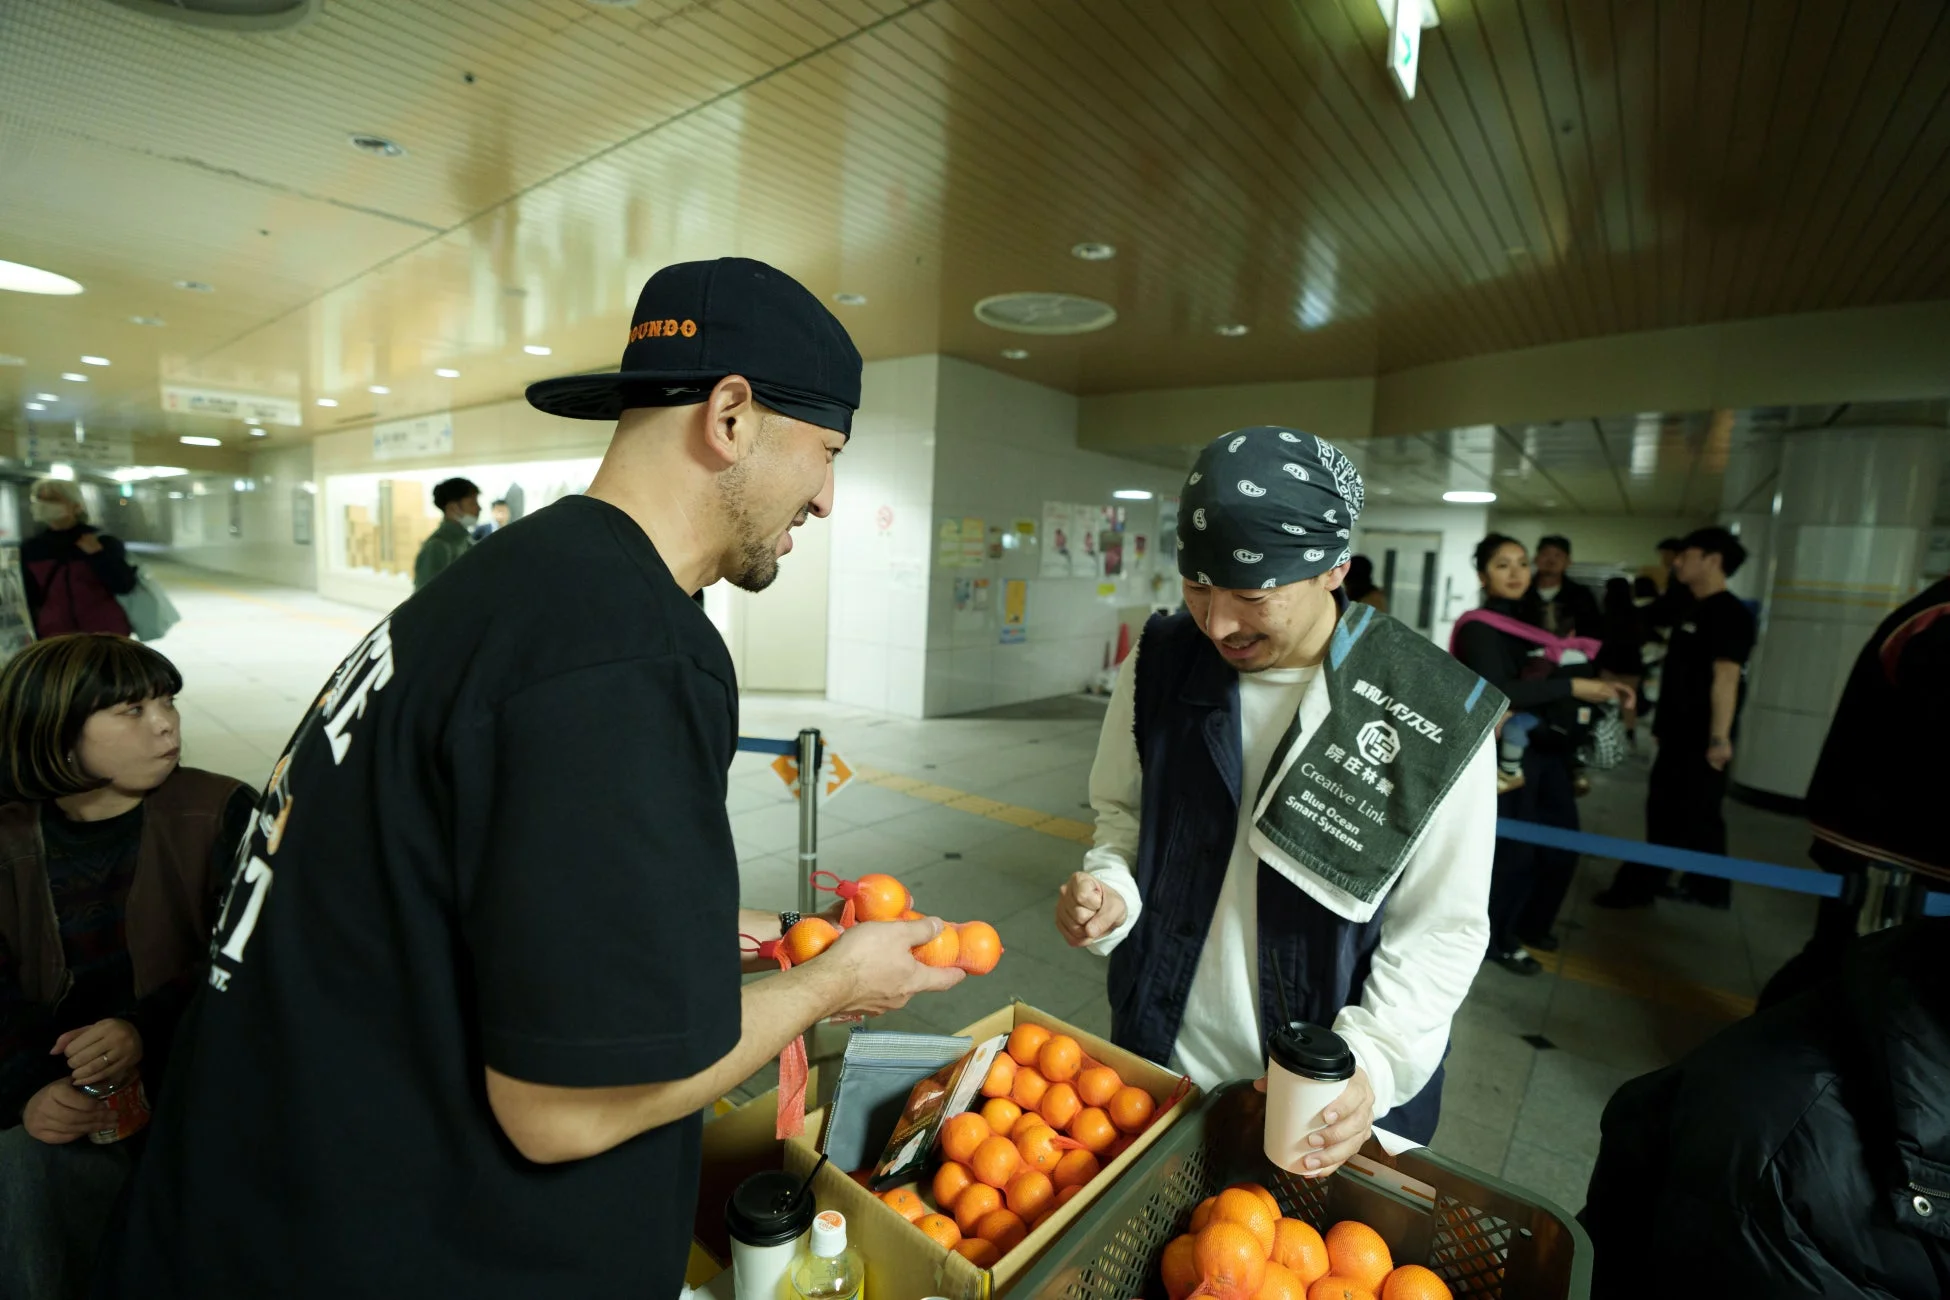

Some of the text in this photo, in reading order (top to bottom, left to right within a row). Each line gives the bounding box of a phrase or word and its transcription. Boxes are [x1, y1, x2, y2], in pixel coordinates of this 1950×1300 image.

[629, 319, 698, 343] OUNDO
[1352, 679, 1443, 743] 東和ハイシステム
[1301, 763, 1387, 827] Creative Link
[1325, 743, 1394, 797] 院庄林業
[1286, 796, 1364, 852] Smart Systems
[1301, 789, 1361, 836] Blue Ocean
